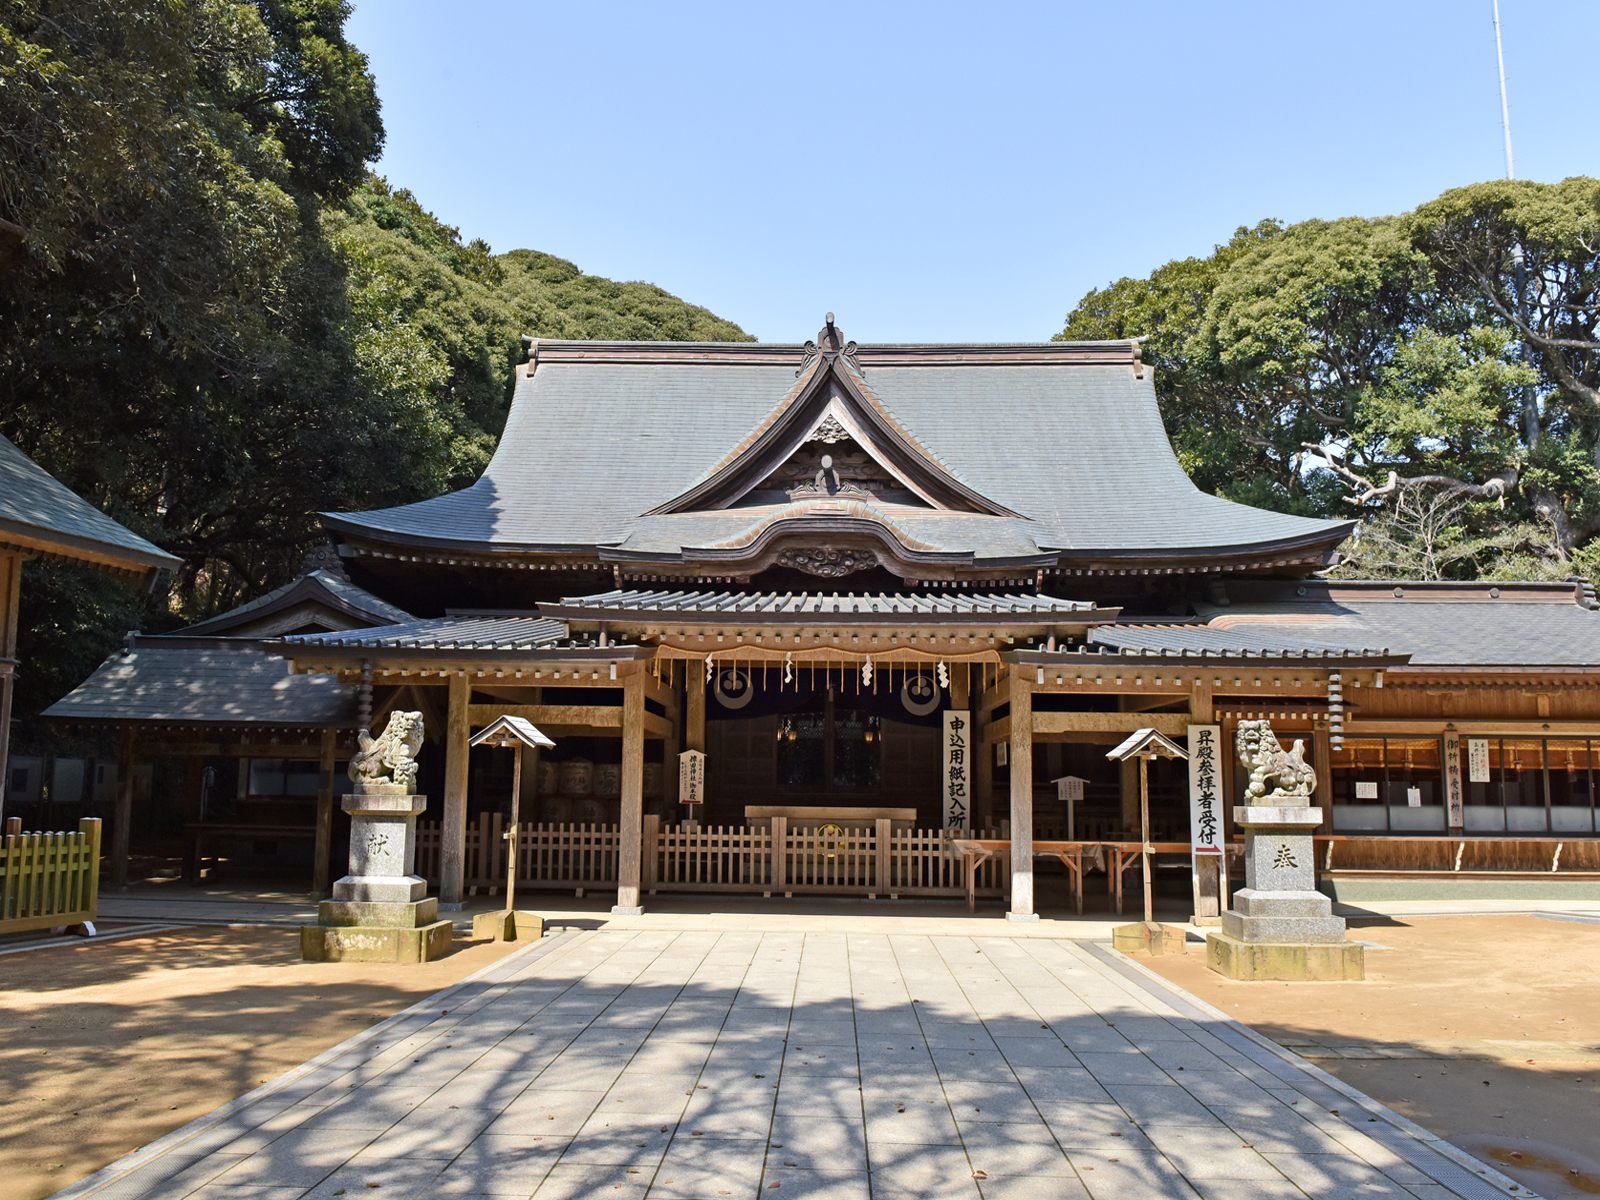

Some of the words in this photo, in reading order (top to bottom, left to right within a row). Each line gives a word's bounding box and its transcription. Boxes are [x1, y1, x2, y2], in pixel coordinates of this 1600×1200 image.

[948, 715, 966, 829] 申込用紙記入所
[1195, 729, 1217, 845] 昇殿参拝者受付
[367, 833, 390, 856] 献
[1272, 844, 1298, 869] 奉
